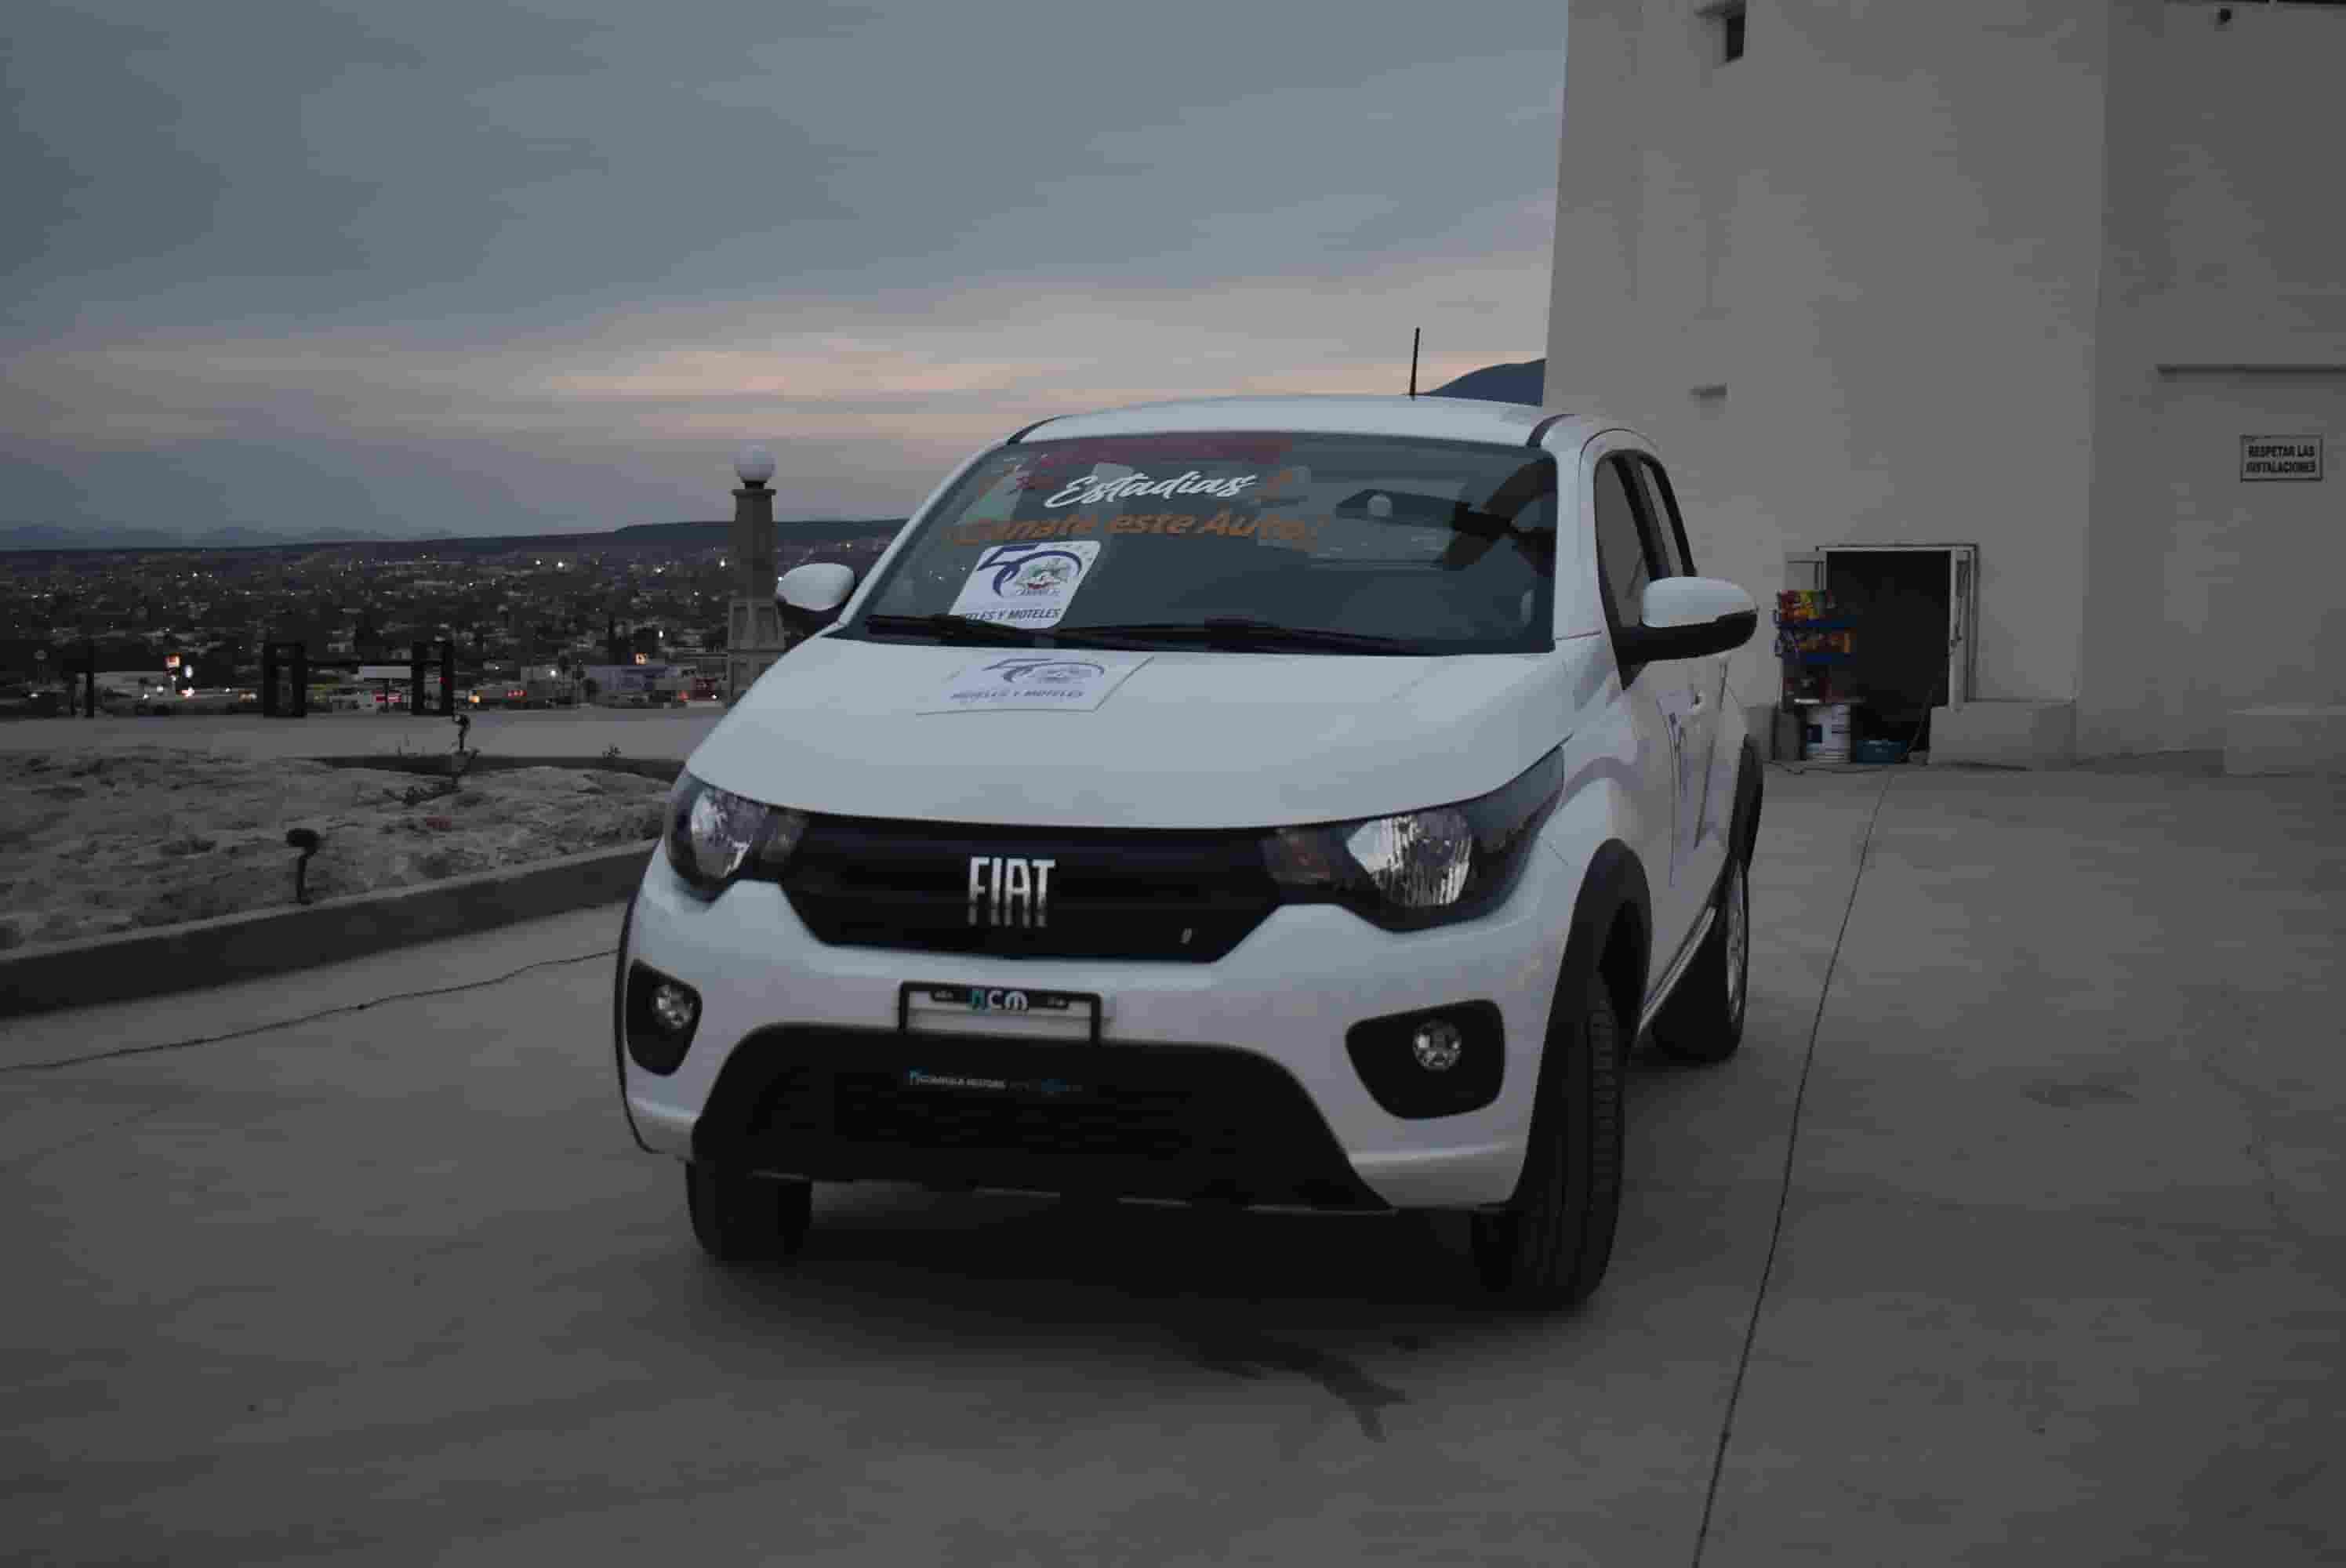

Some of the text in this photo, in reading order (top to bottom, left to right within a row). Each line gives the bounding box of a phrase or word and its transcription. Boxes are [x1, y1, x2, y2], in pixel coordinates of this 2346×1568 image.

[2248, 445, 2315, 457] RESPETAR LAS
[1004, 608, 1061, 619] MOTELES
[968, 856, 1058, 927] FIAT
